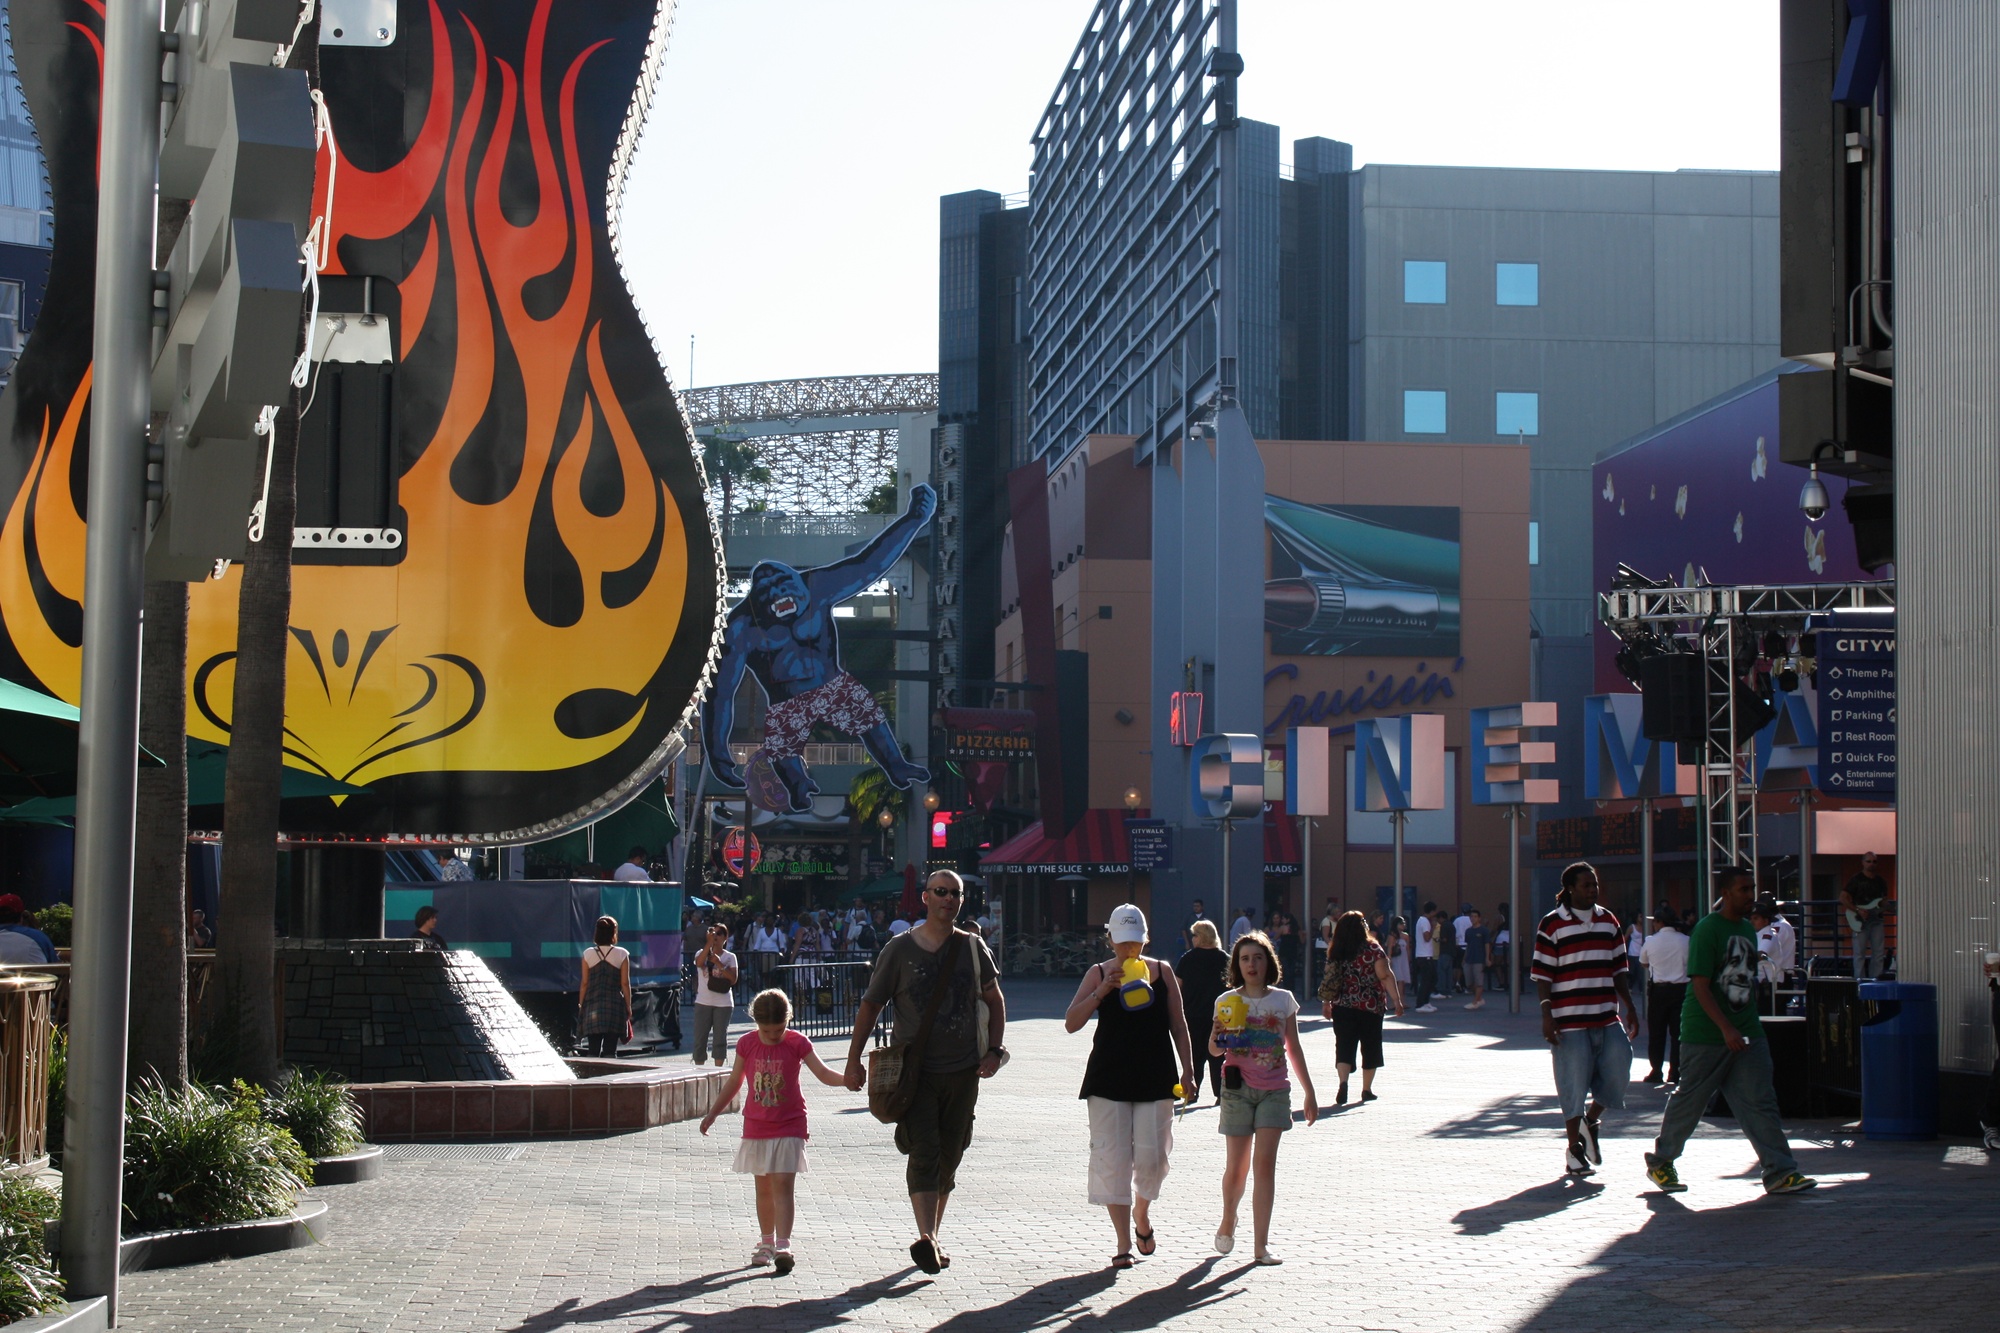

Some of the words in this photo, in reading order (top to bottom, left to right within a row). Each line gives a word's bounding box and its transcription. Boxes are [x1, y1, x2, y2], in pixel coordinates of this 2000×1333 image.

[935, 447, 955, 708] CITYWALK
[1846, 668, 1879, 678] Theme
[1846, 710, 1883, 722] Parking
[1846, 732, 1867, 741] Rest
[956, 735, 1030, 749] PIZZERIA
[959, 749, 1024, 757] PUCCINO
[1846, 752, 1875, 762] Quick
[790, 862, 834, 873] GRILL
[1007, 865, 1022, 873] PIZZA
[1027, 865, 1038, 873] BY
[1039, 865, 1056, 873] THE
[1058, 865, 1082, 873] SLICE
